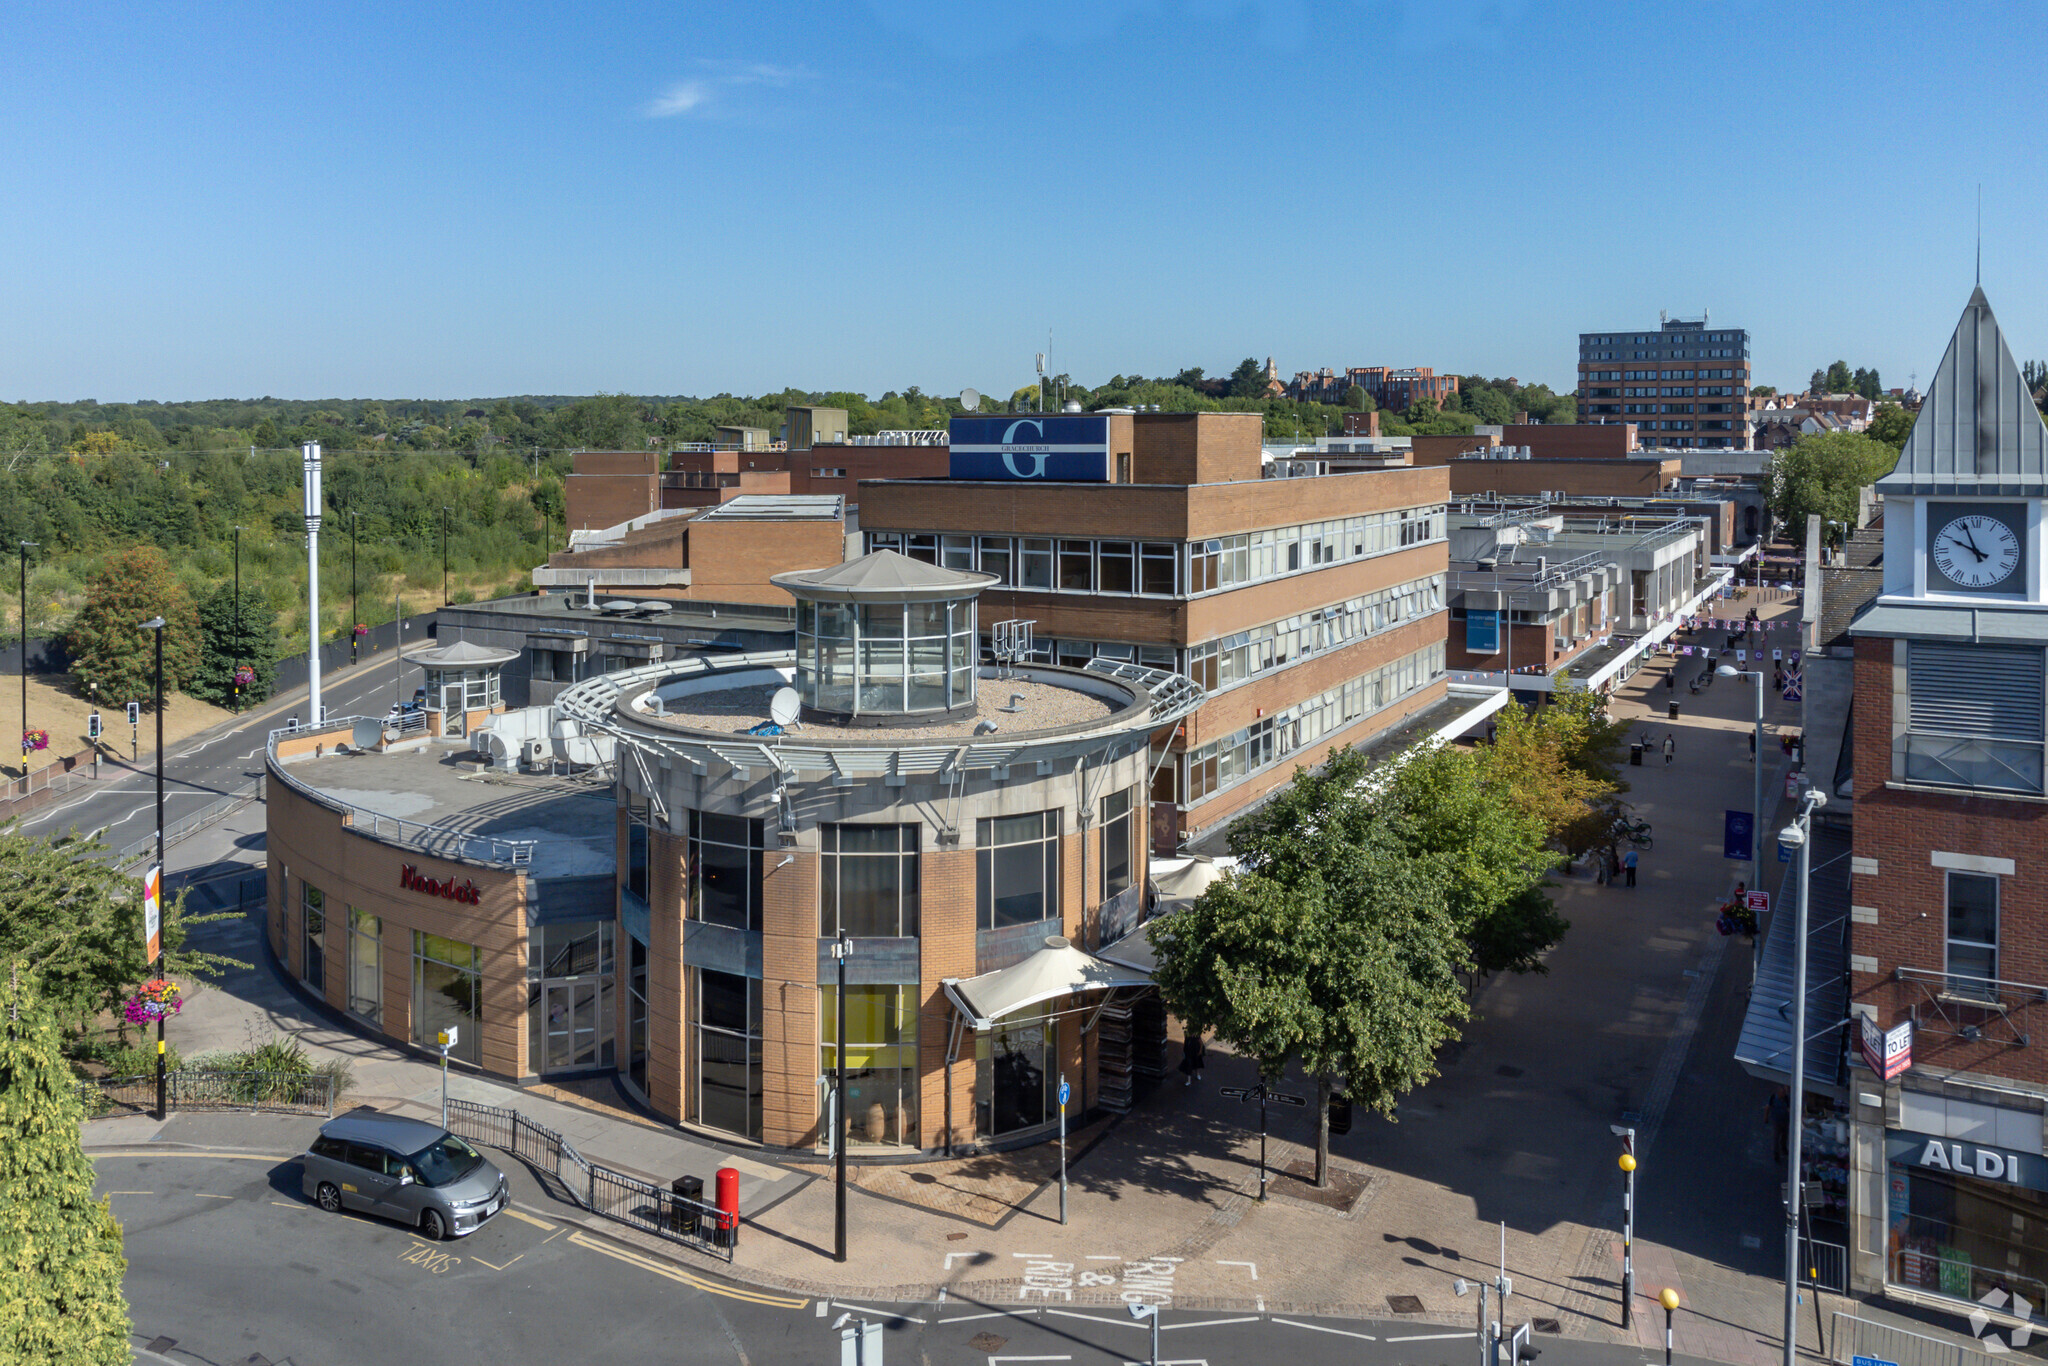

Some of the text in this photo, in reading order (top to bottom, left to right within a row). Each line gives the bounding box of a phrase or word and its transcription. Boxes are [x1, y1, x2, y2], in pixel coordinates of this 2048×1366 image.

[1002, 419, 1050, 478] G
[400, 863, 480, 906] Nando's
[1888, 1034, 1911, 1055] TO LET
[1920, 1140, 2018, 1183] ALDI
[397, 1241, 462, 1274] TAXIS
[1019, 1260, 1074, 1301] RIDE
[1078, 1271, 1116, 1287] &
[1120, 1261, 1176, 1305] RING
